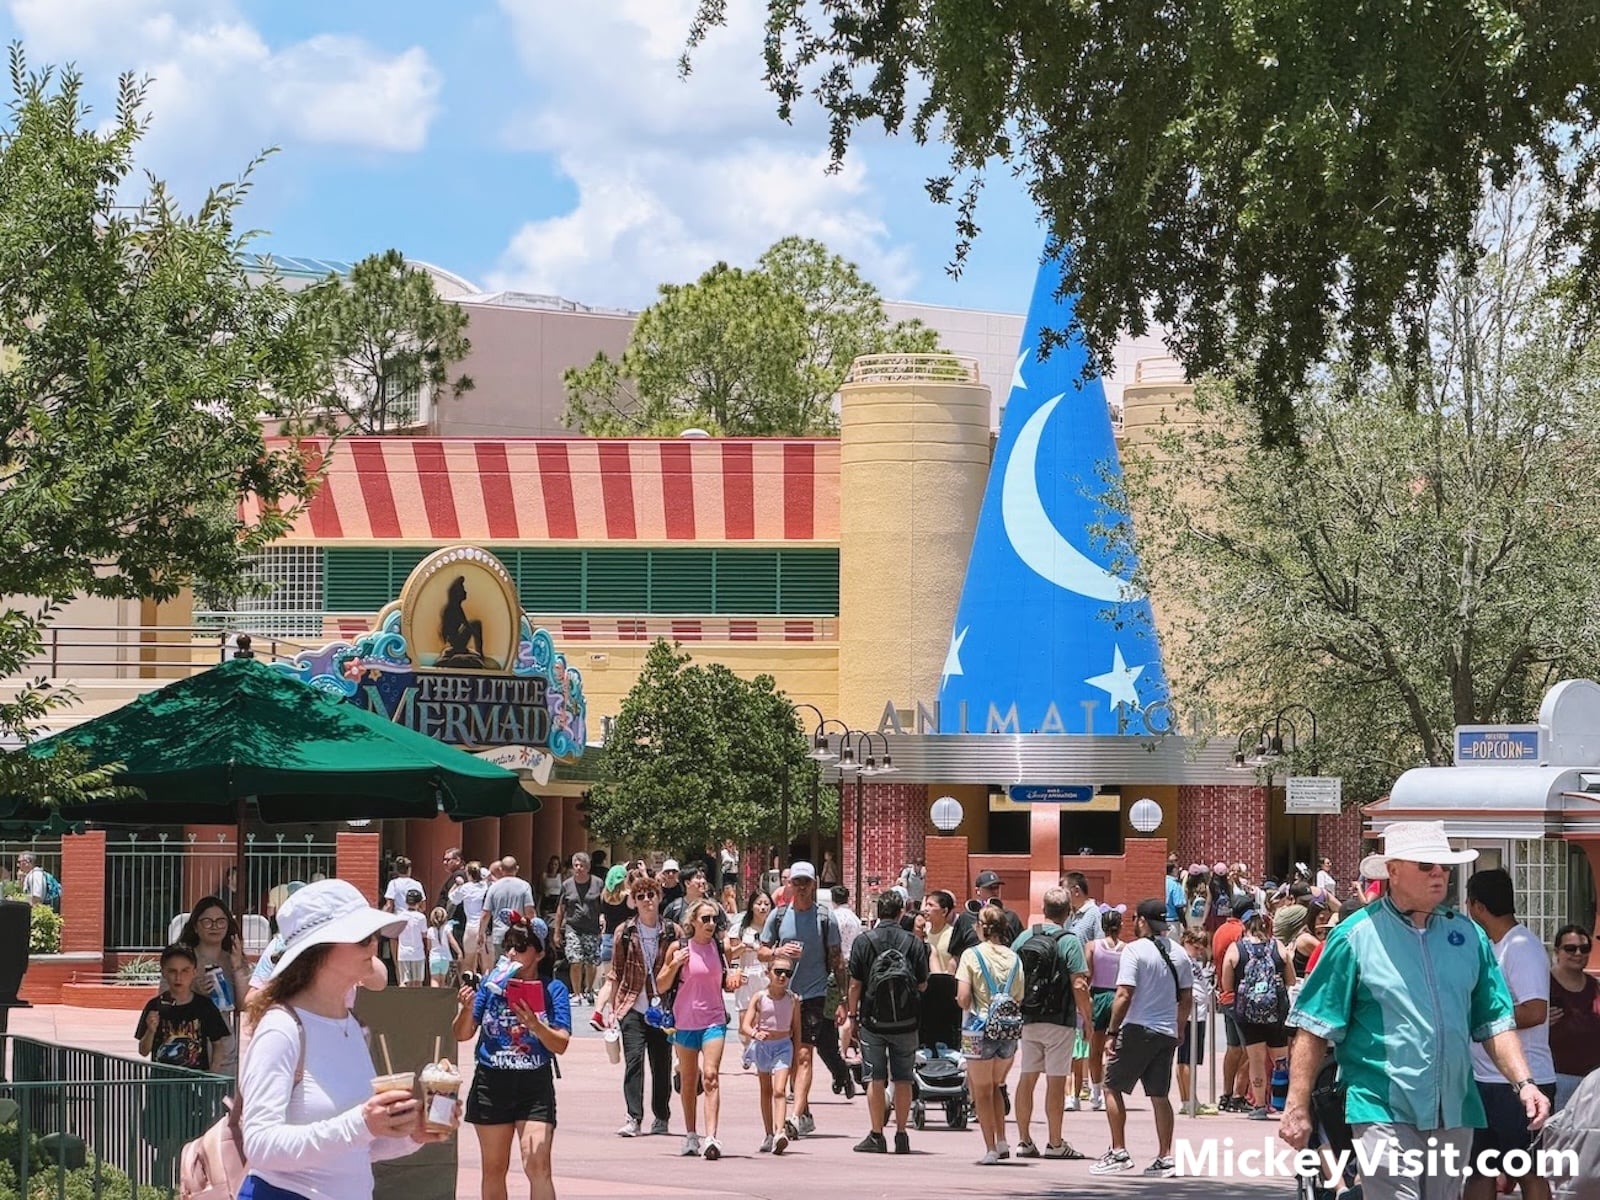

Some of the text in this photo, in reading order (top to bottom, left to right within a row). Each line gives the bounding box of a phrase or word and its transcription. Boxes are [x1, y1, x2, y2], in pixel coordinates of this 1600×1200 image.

[417, 675, 545, 705] THE LITTLE
[362, 684, 550, 748] MERMAID
[1472, 740, 1523, 759] POPCORN
